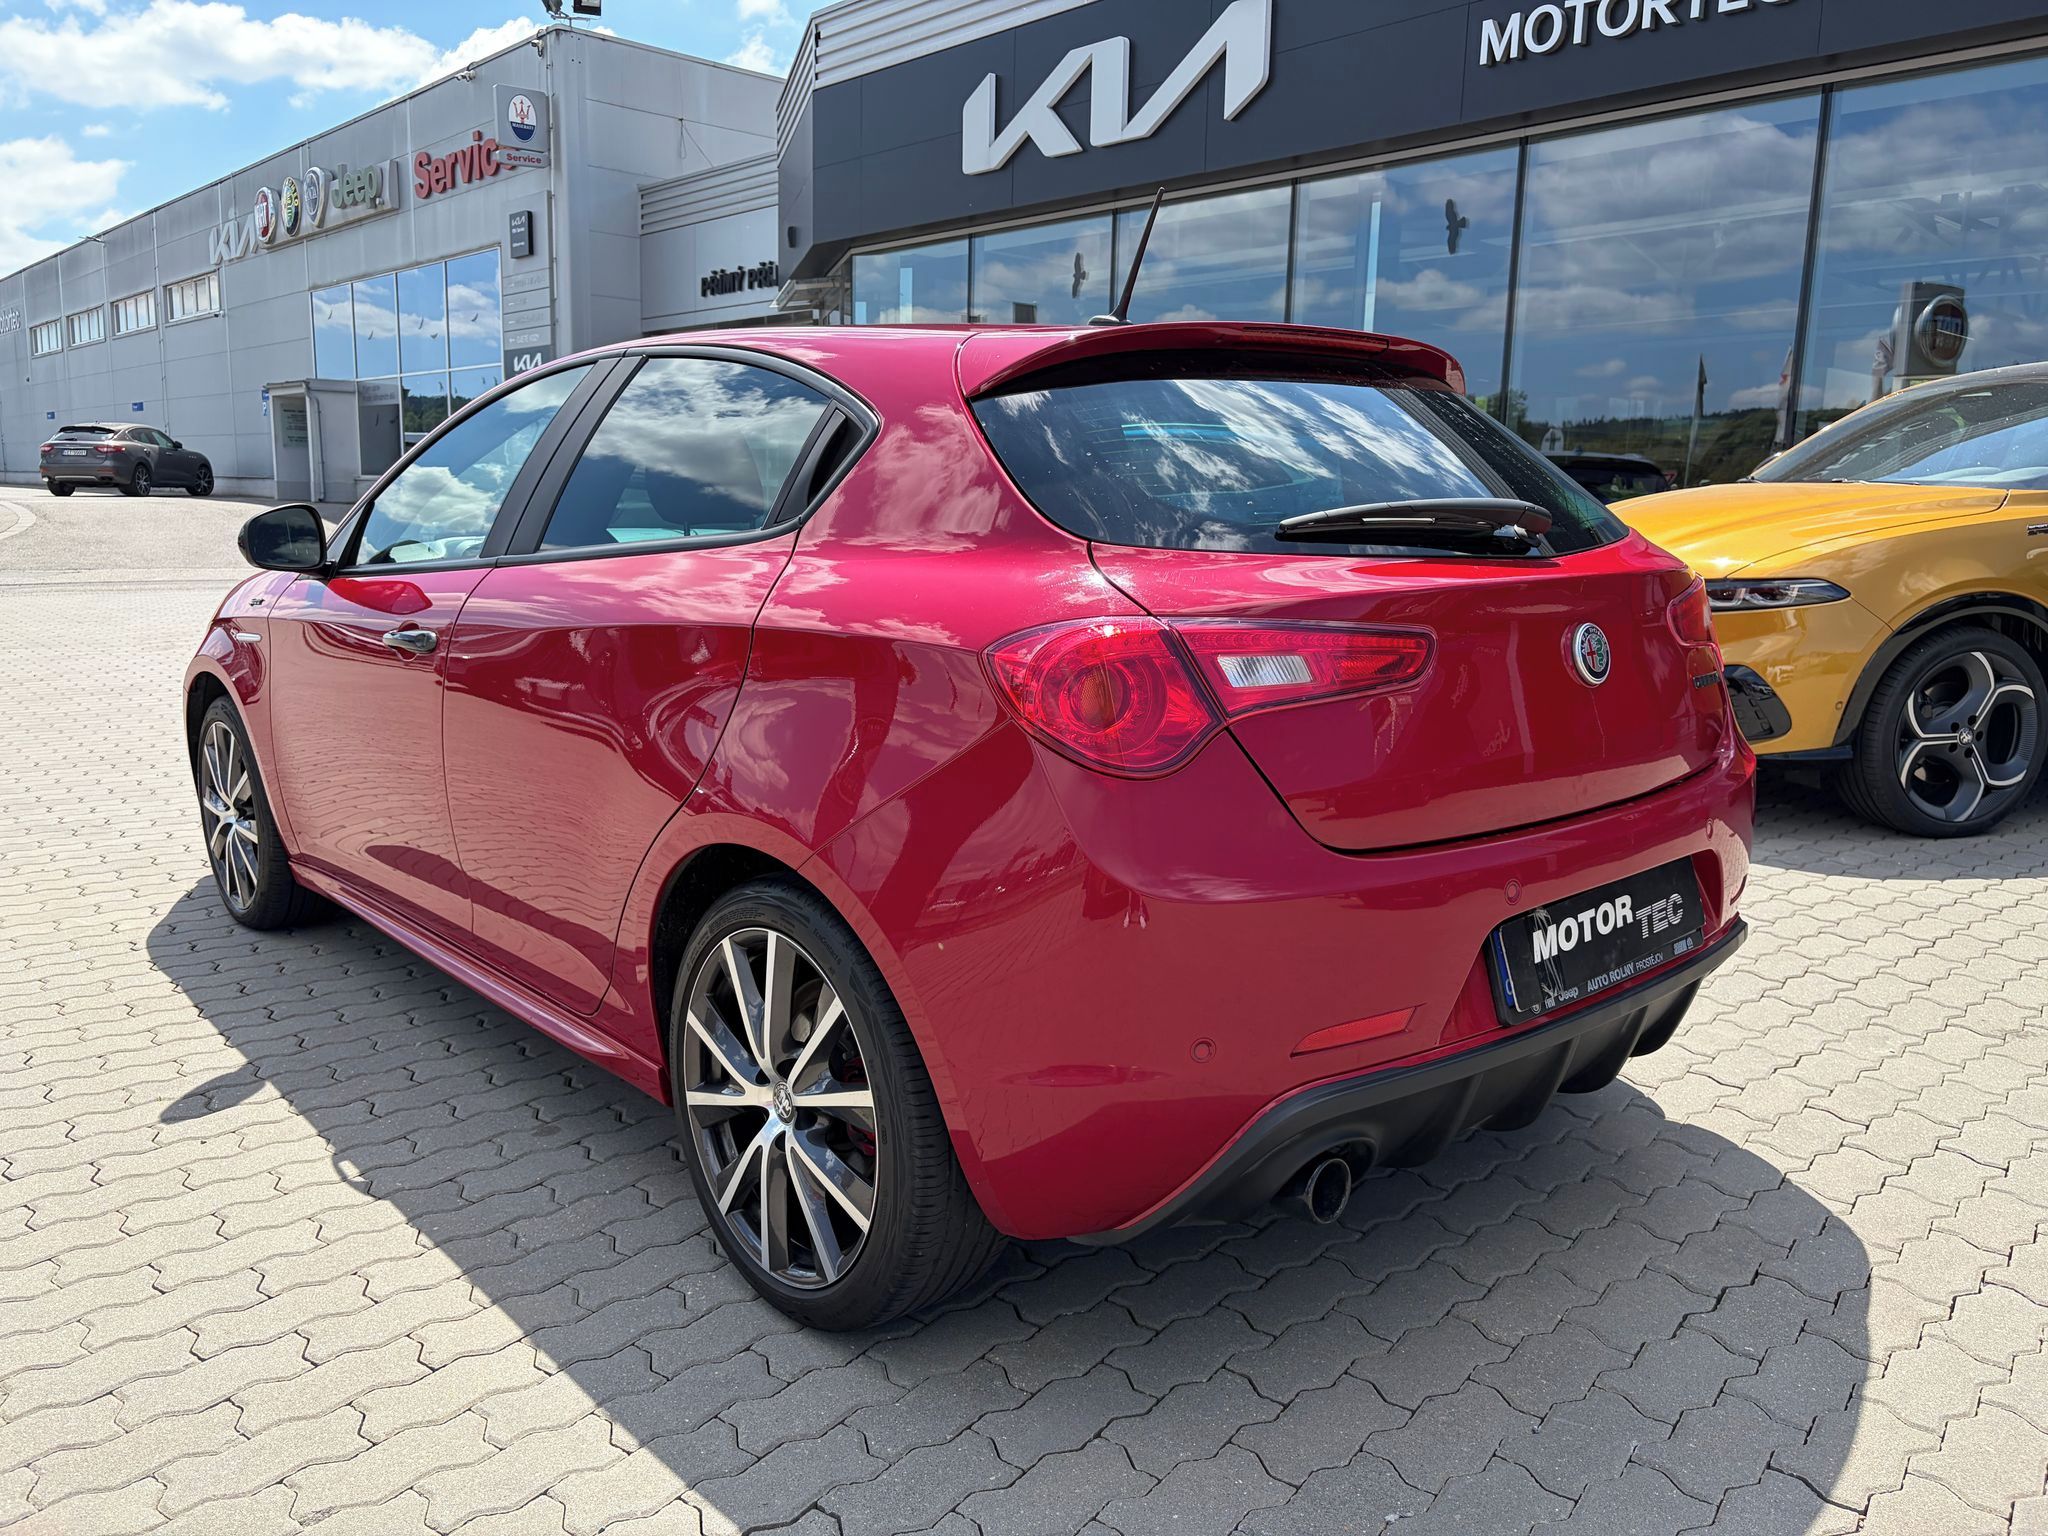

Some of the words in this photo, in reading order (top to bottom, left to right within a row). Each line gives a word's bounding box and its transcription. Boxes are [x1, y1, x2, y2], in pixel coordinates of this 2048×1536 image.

[1479, 0, 1792, 66] MOTOR
[506, 153, 542, 164] Service
[332, 164, 384, 210] Jeep
[1532, 894, 1634, 964] MOTOR
[1636, 893, 1684, 939] TEC
[1587, 974, 1609, 992] AUTO
[1609, 962, 1635, 983] ROLNY
